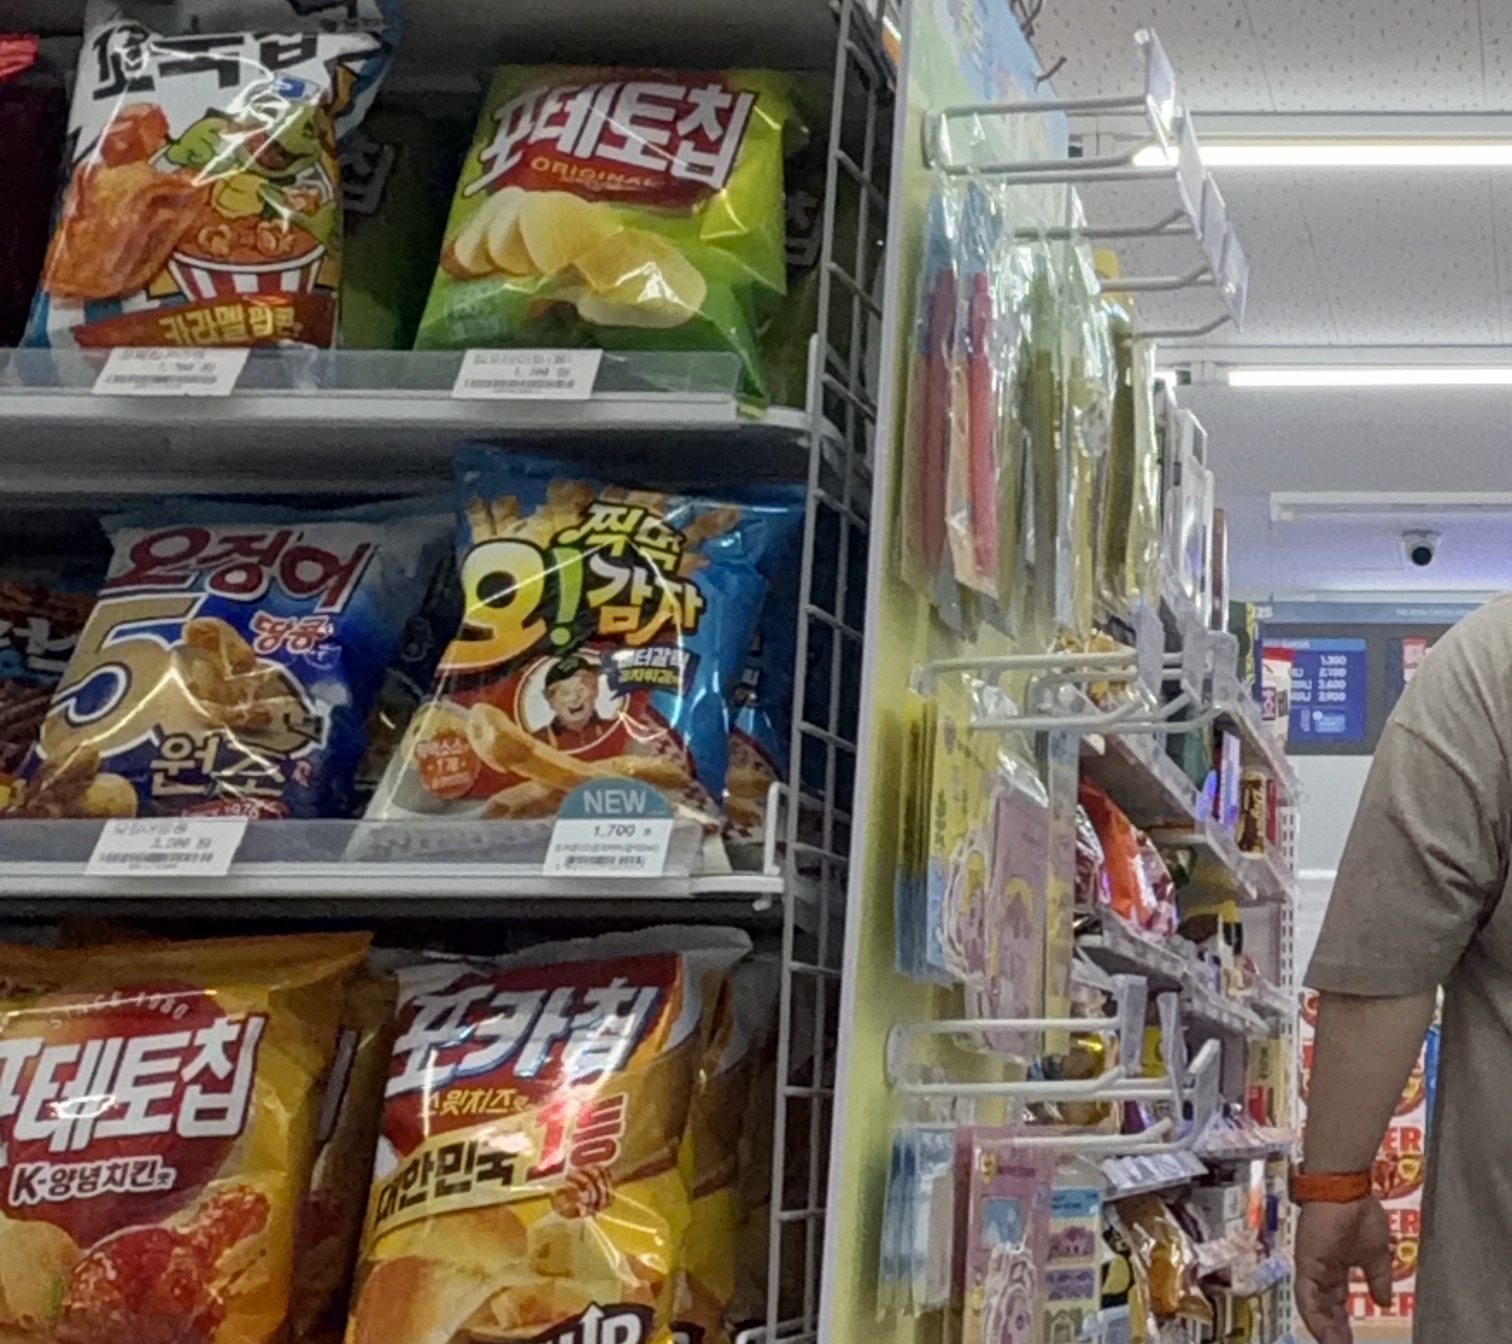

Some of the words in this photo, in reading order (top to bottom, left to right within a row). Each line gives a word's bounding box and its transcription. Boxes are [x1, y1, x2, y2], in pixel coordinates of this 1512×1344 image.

[462, 80, 758, 199] 포테토칩
[530, 156, 657, 188] ORIGINAL
[106, 527, 373, 614] 오징어
[586, 553, 707, 647] 감자
[252, 612, 333, 655] 땅콩
[150, 732, 287, 799] 원조
[583, 789, 647, 815] NEW
[593, 824, 636, 838] 1,700
[384, 976, 668, 1099] 포카칩
